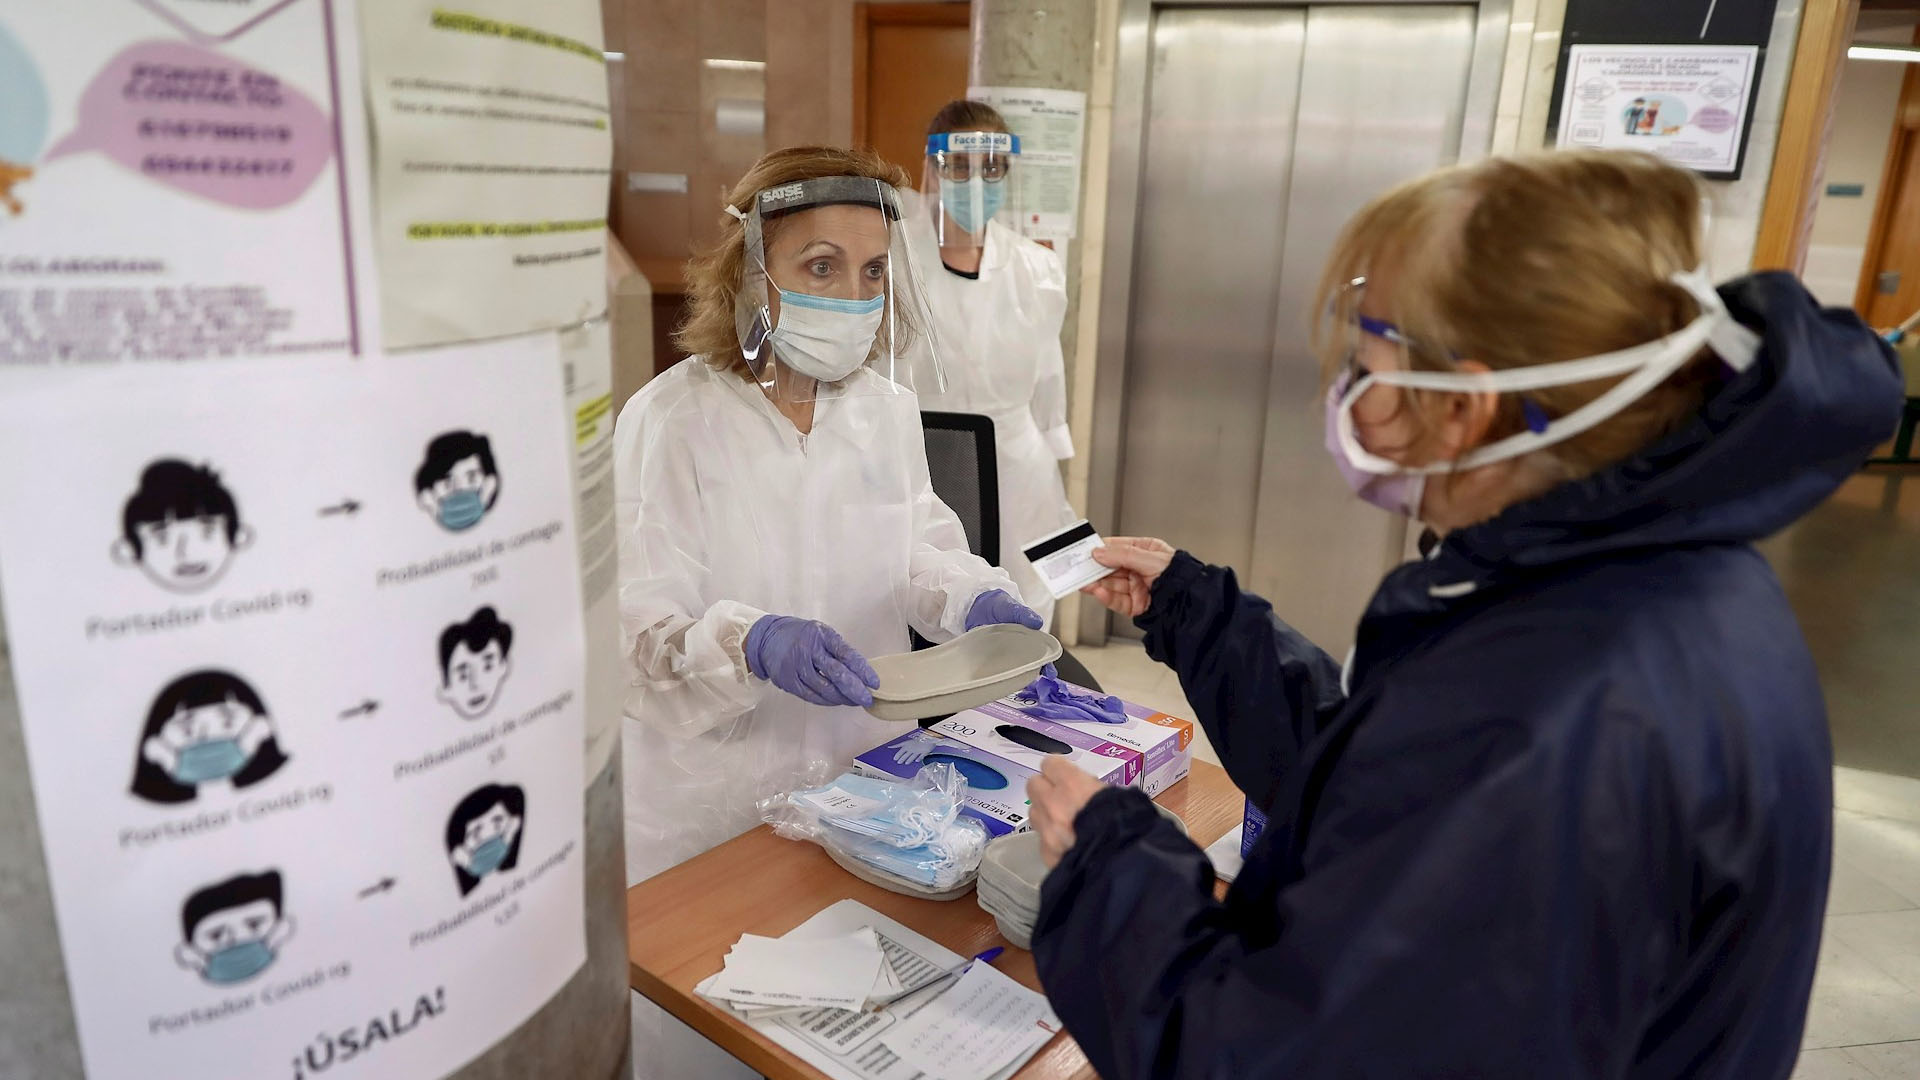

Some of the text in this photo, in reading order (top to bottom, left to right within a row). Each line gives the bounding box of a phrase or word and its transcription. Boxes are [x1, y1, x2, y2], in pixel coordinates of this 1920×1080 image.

[954, 133, 1007, 145] Face Sheld
[762, 183, 803, 203] SATSE
[375, 521, 563, 587] Probabilidad de contagio
[85, 607, 205, 642] Portador
[942, 721, 976, 736] 200
[1183, 729, 1190, 740] S
[394, 725, 497, 782] Probabilidad
[502, 719, 517, 735] de
[1129, 760, 1137, 771] M
[964, 794, 1007, 816] MEDIGU
[118, 809, 232, 849] Portador
[409, 887, 507, 951] Probabilidad
[148, 994, 255, 1035] Portador
